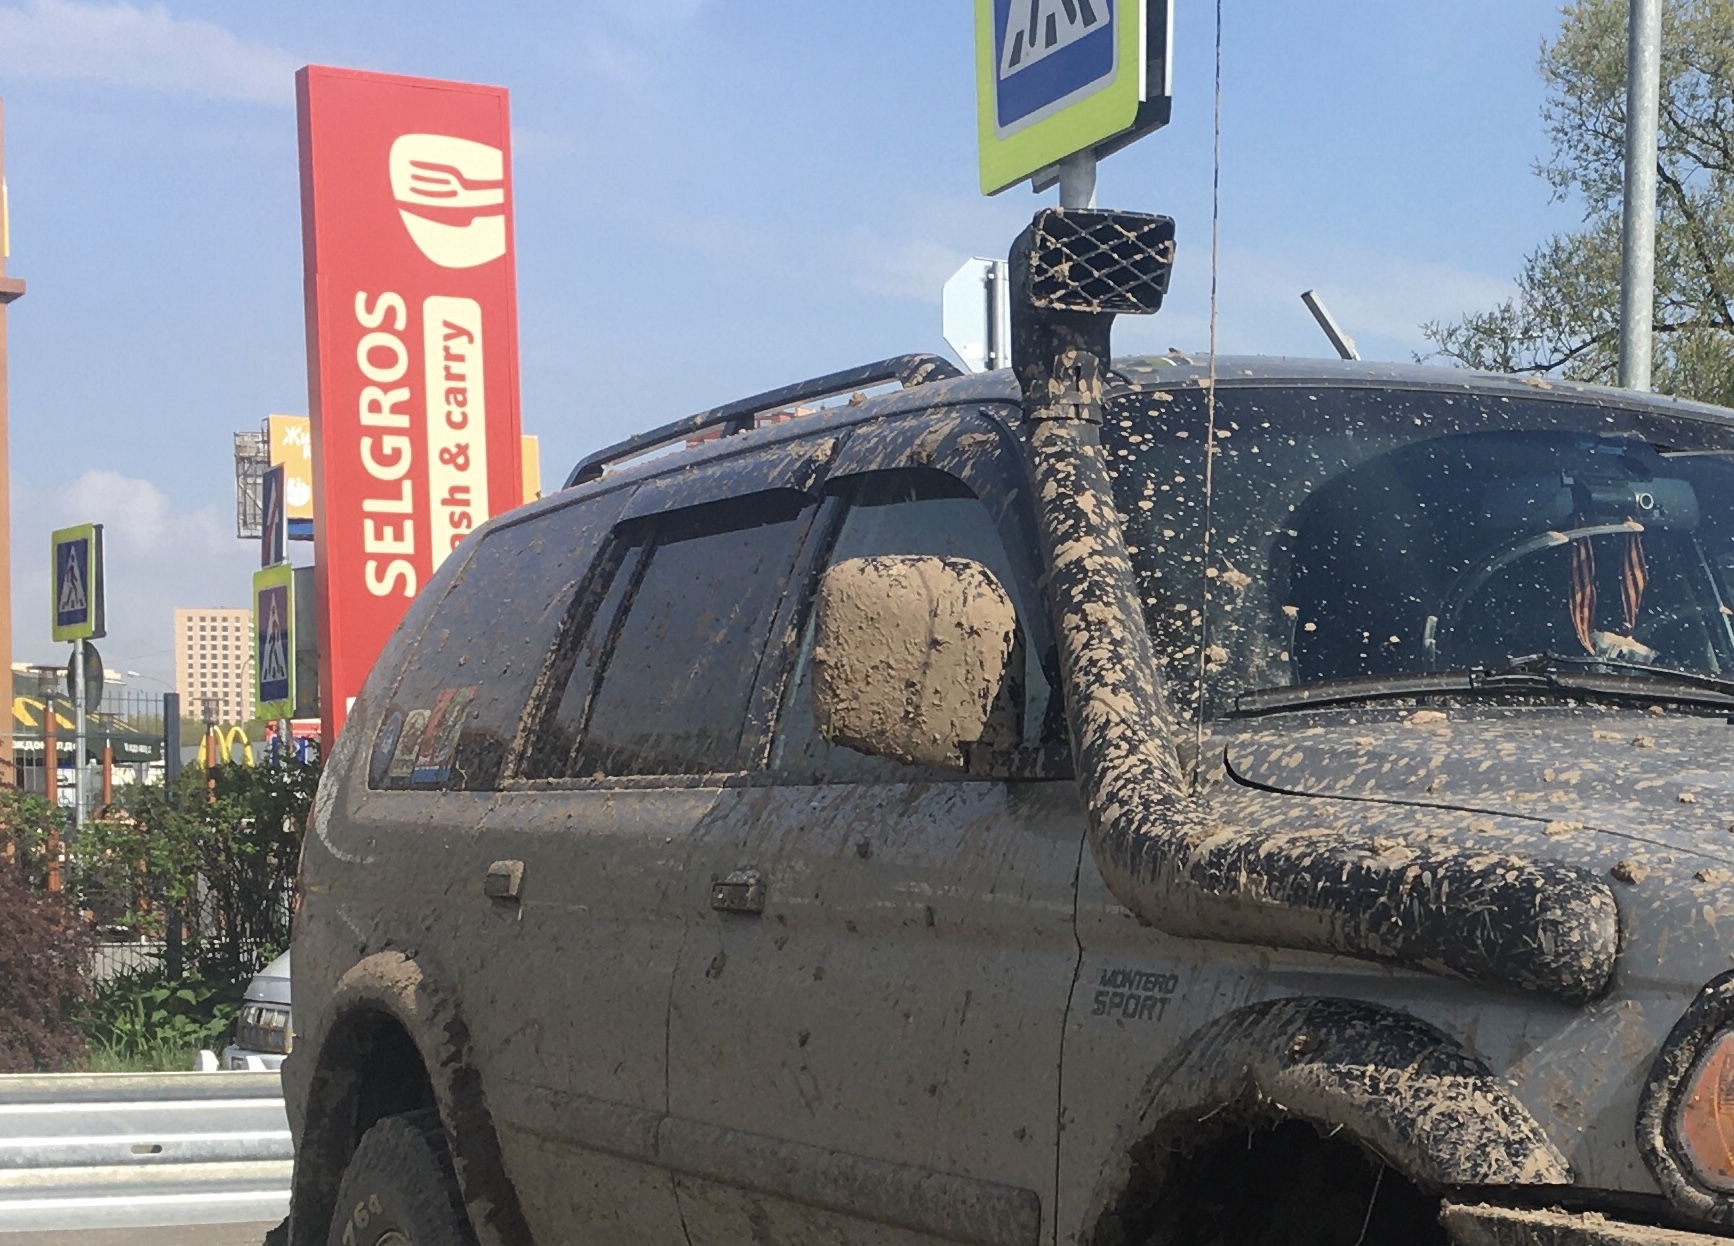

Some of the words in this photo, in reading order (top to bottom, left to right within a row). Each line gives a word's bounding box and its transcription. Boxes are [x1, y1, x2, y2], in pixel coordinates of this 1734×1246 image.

[443, 319, 475, 431] carry
[355, 290, 417, 598] SELGROS
[439, 442, 470, 473] &
[441, 485, 472, 552] ash
[1090, 989, 1173, 1022] SPORT
[1099, 968, 1179, 995] MONTERO
